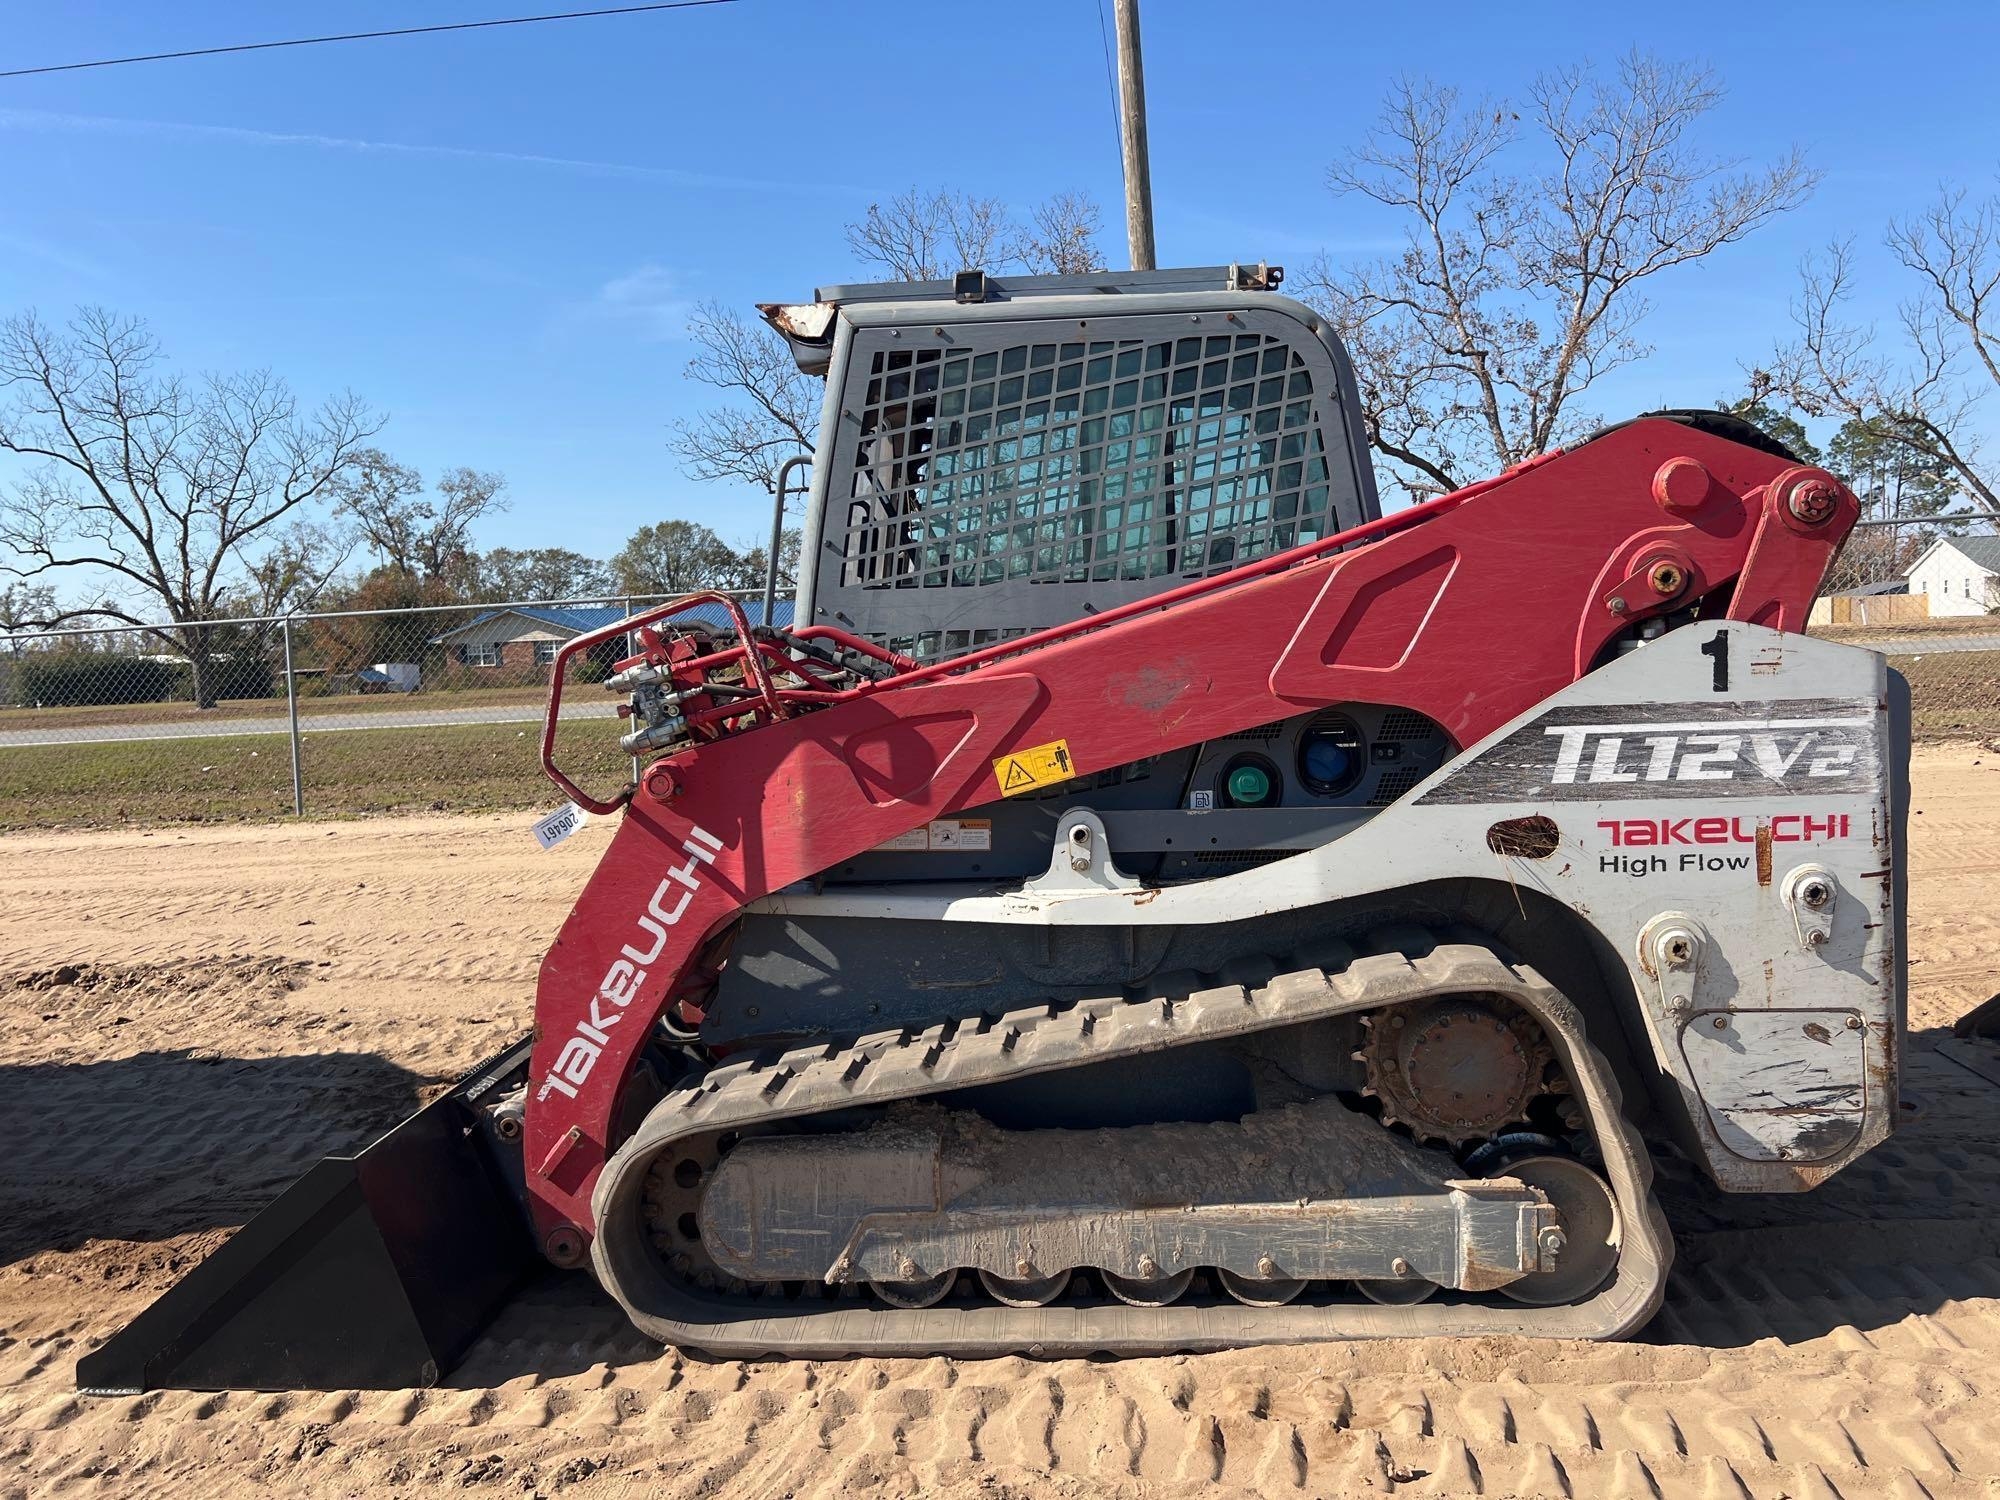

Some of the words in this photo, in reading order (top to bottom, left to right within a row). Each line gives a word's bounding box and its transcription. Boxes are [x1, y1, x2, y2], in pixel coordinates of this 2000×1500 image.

[1701, 629, 1728, 692] 1
[542, 812, 579, 842] 206461
[1599, 854, 1667, 878] High
[1679, 853, 1751, 872] Flow
[536, 825, 725, 1102] TAKEUCHI
